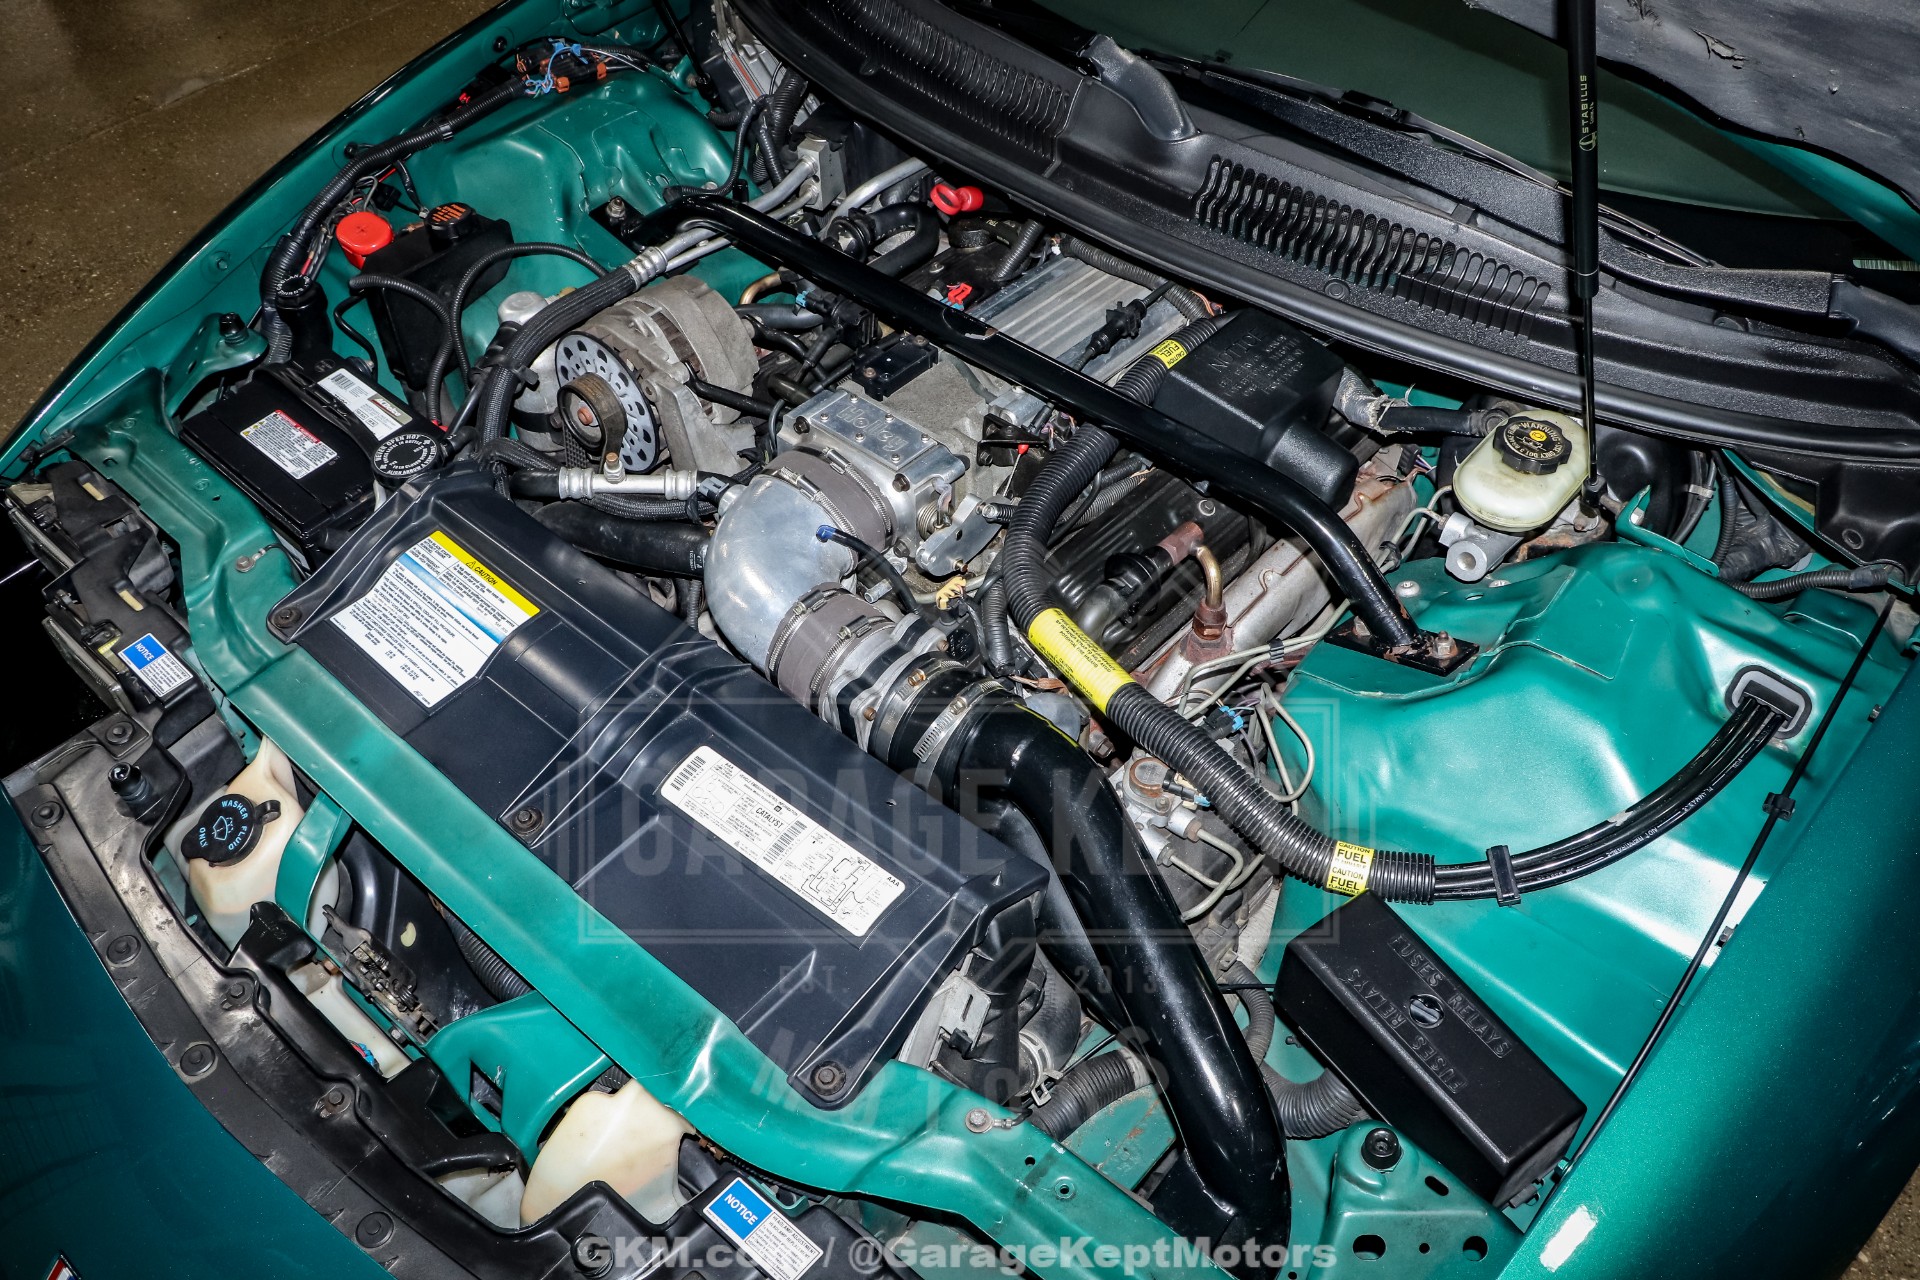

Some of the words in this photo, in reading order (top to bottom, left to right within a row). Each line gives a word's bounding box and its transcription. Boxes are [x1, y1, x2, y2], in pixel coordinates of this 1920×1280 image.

[1579, 74, 1589, 133] STABILUS
[1159, 342, 1180, 359] FUEL
[837, 404, 908, 451] Holley
[1520, 421, 1560, 442] WARNING
[473, 566, 497, 585] CAUTION
[134, 642, 155, 661] NOTICE
[221, 799, 248, 819] WASHER
[754, 807, 783, 828] CATALYST
[198, 827, 208, 847] ONLY
[228, 825, 247, 850] FLUID
[1338, 842, 1370, 853] CAUTION
[1336, 848, 1367, 863] FUEL
[1330, 875, 1360, 890] FUEL
[1331, 866, 1363, 879] CAUTION
[1343, 966, 1407, 1034] RELAYS
[1387, 932, 1444, 989] FUSES
[1445, 991, 1512, 1058] RELAYS
[1408, 1031, 1468, 1097] FUSES
[723, 1193, 758, 1225] NOTICE
[771, 1215, 792, 1234] HEADLAMP
[791, 1233, 816, 1255] ADJUSTMENT
